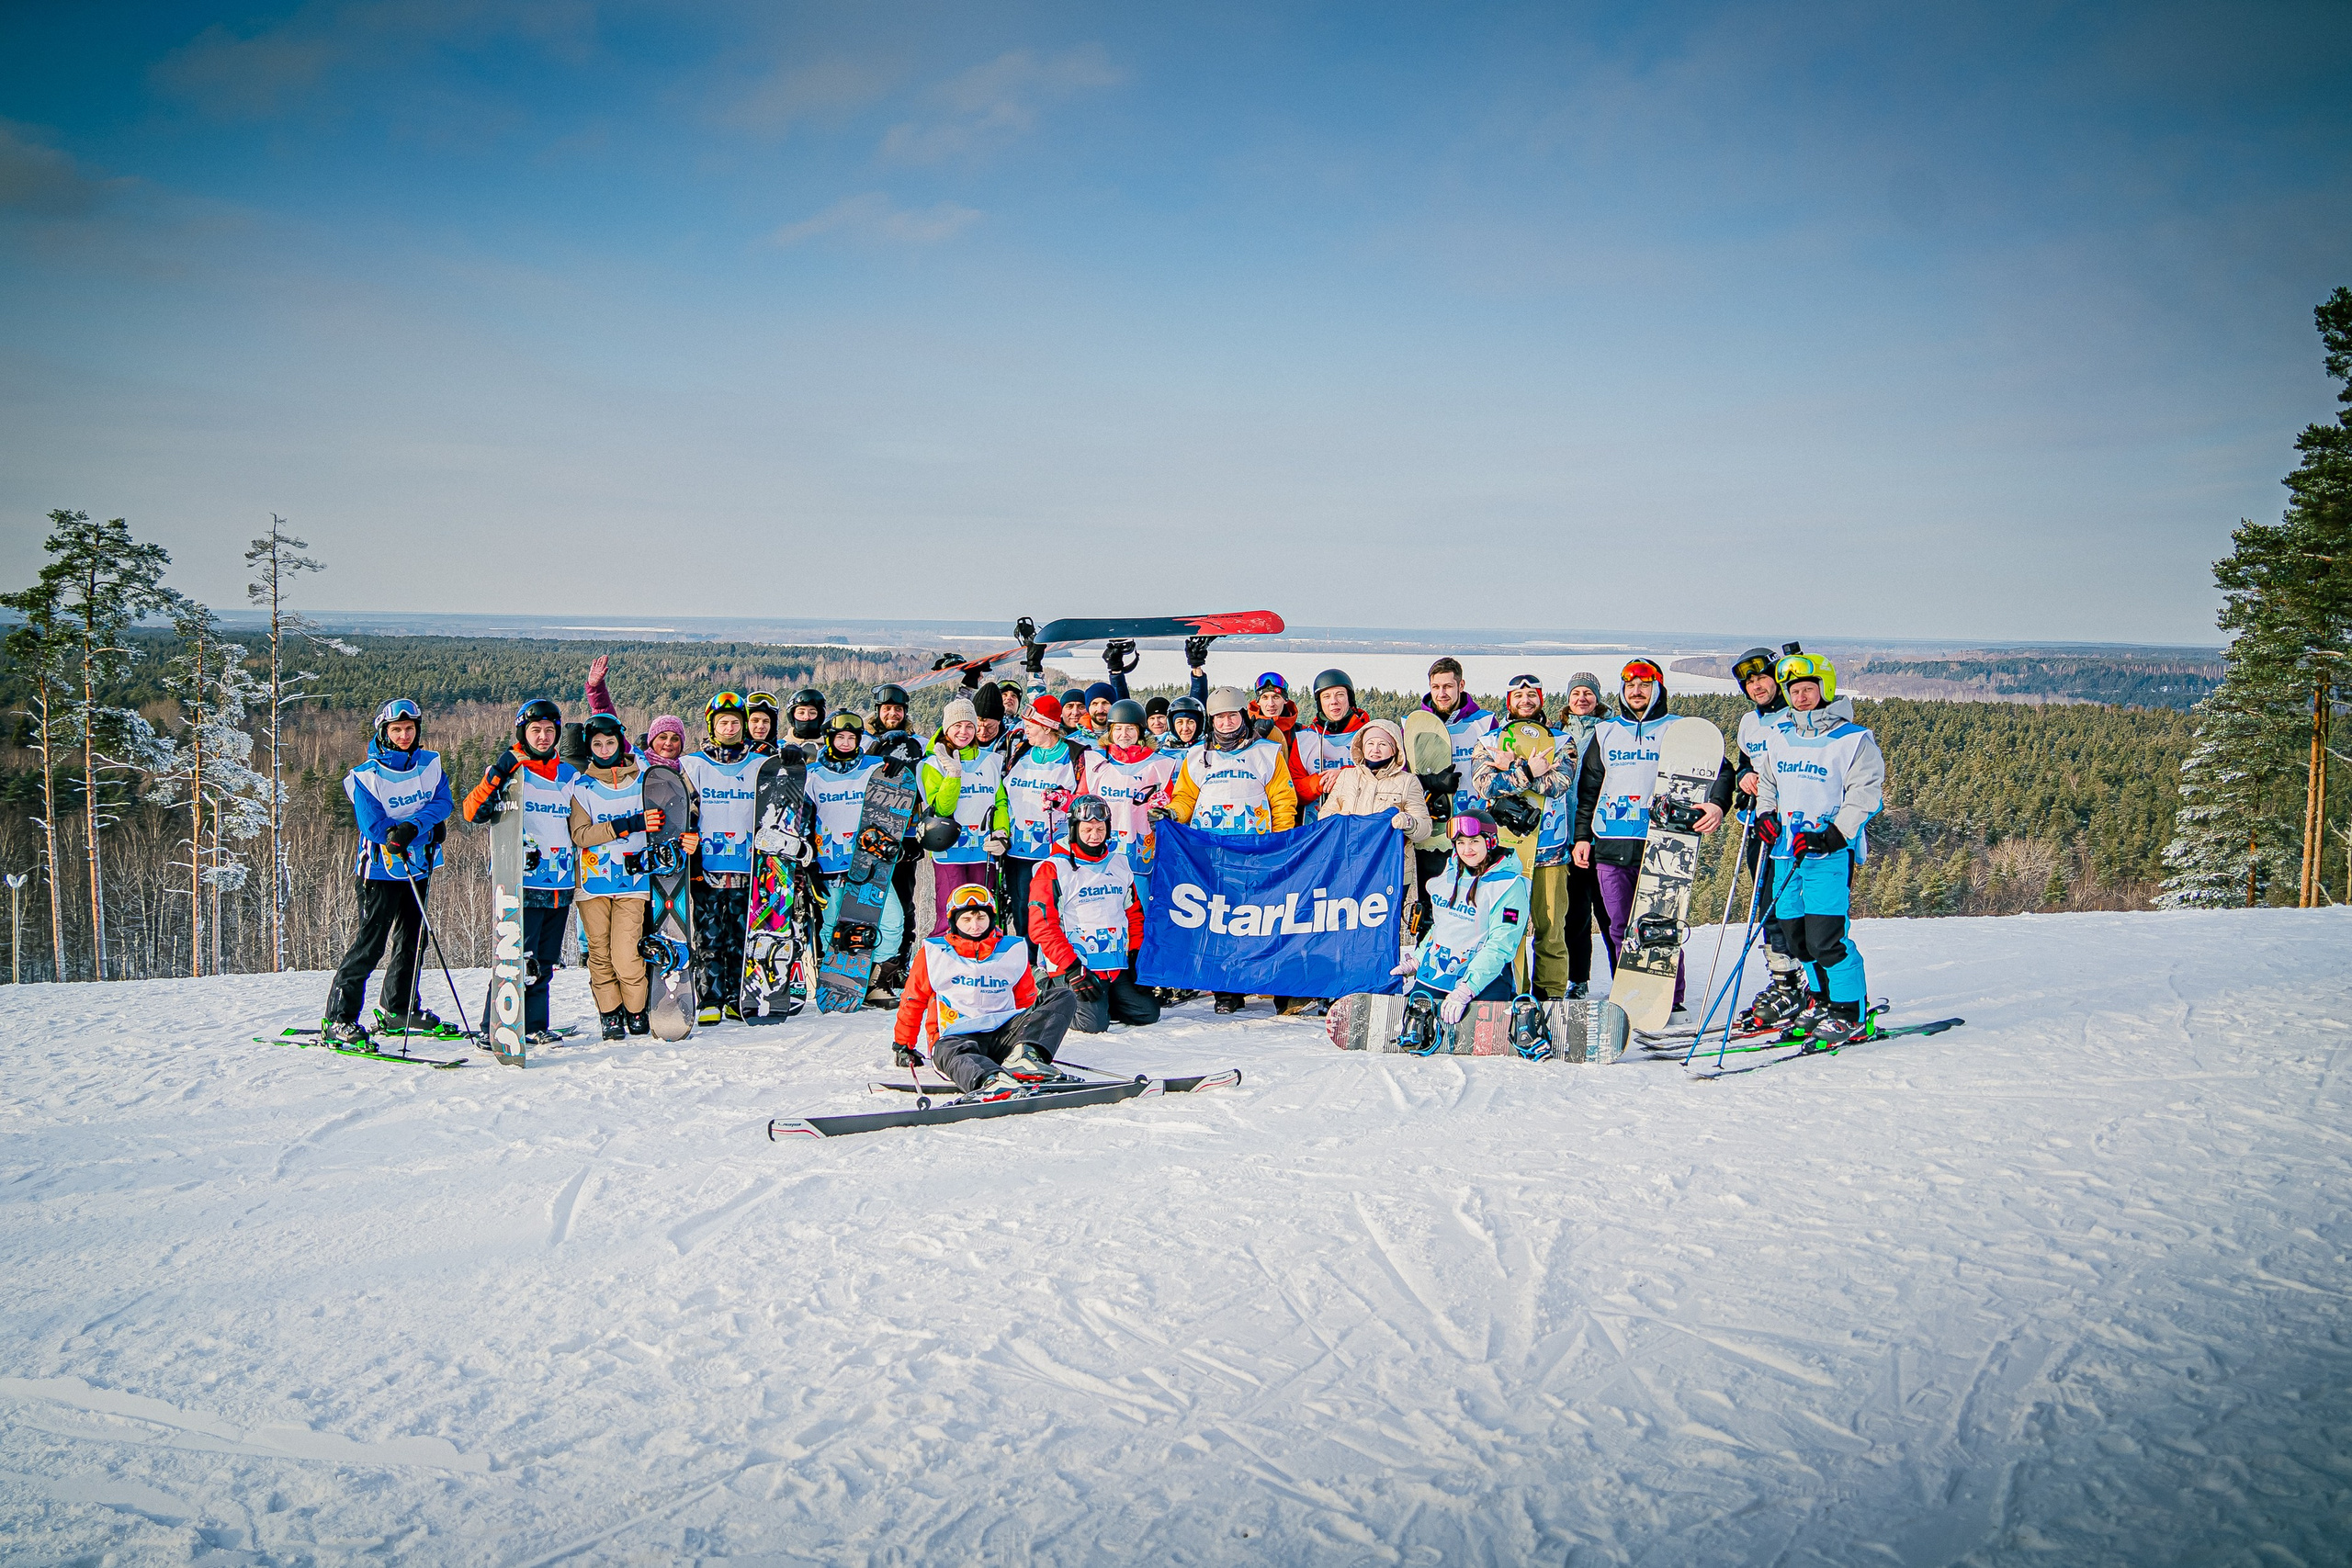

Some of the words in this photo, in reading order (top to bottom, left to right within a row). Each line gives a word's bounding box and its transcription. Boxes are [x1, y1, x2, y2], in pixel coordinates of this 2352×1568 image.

[1608, 750, 1659, 761] StarLin
[1777, 761, 1827, 776] StarLine
[702, 787, 755, 799] StarLine
[960, 784, 994, 794] arLine
[819, 790, 864, 804] StarLin
[1079, 884, 1123, 897] StarLine
[495, 885, 521, 1055] JOINT
[951, 976, 1009, 987] StarLine
